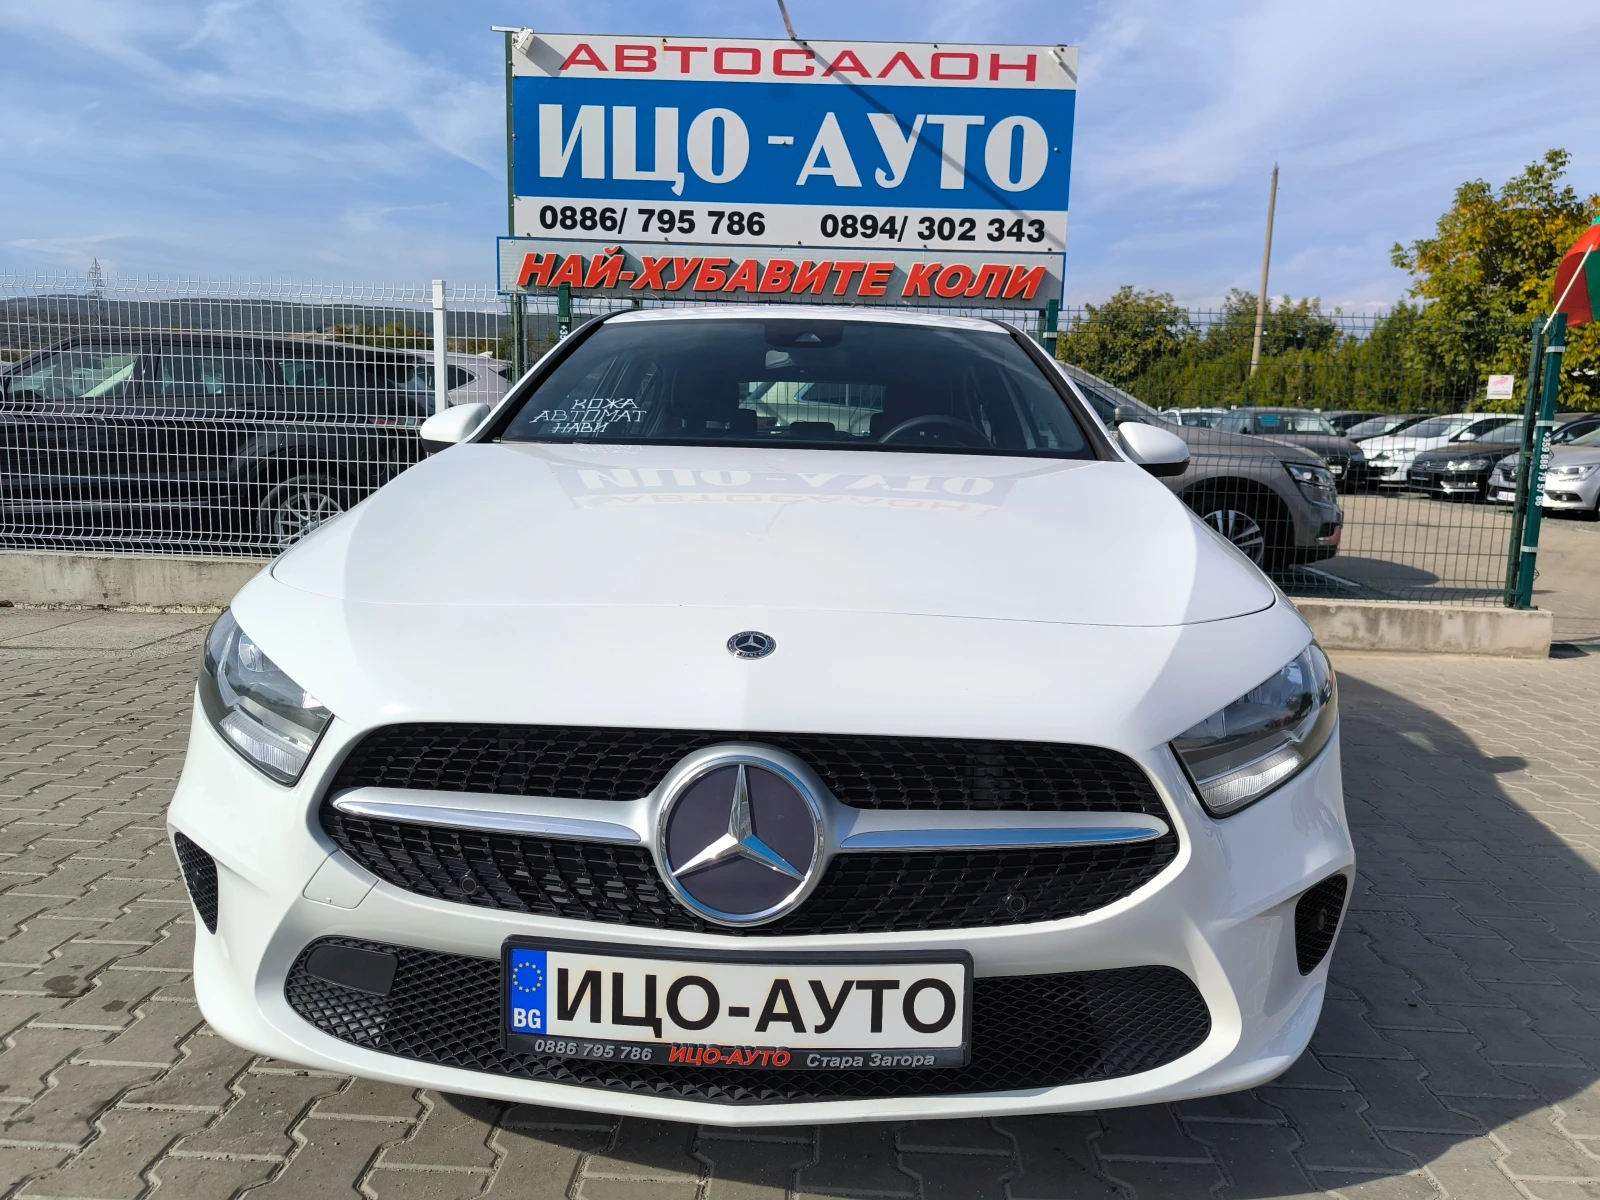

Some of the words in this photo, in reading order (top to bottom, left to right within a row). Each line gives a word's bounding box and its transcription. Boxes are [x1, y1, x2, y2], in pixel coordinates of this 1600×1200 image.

[558, 43, 1038, 82] АВТОСАЛОН
[539, 204, 628, 235] 0886/
[637, 208, 696, 234] 795
[707, 210, 766, 236] 786
[820, 213, 909, 243] 0894/
[917, 216, 977, 242] 302
[986, 217, 1046, 243] 343
[516, 245, 895, 297] НАЙ-ХУБАВИТЕ
[901, 262, 1046, 300] КОЛИ
[559, 324, 569, 342] +35
[570, 398, 640, 410] КОЖА
[529, 409, 647, 423] АВТОМАТ
[550, 422, 609, 435] НАВИ
[1541, 431, 1552, 453] +359
[1539, 454, 1549, 470] 886
[557, 967, 957, 1039] ИЦО-АУТО
[513, 1007, 541, 1029] BG
[534, 1039, 577, 1056] 0886
[583, 1043, 615, 1058] 795
[620, 1046, 653, 1061] 786
[669, 1044, 791, 1067] ИЦО-АУТО
[806, 1053, 864, 1069] Стара
[869, 1052, 935, 1067] Загора
